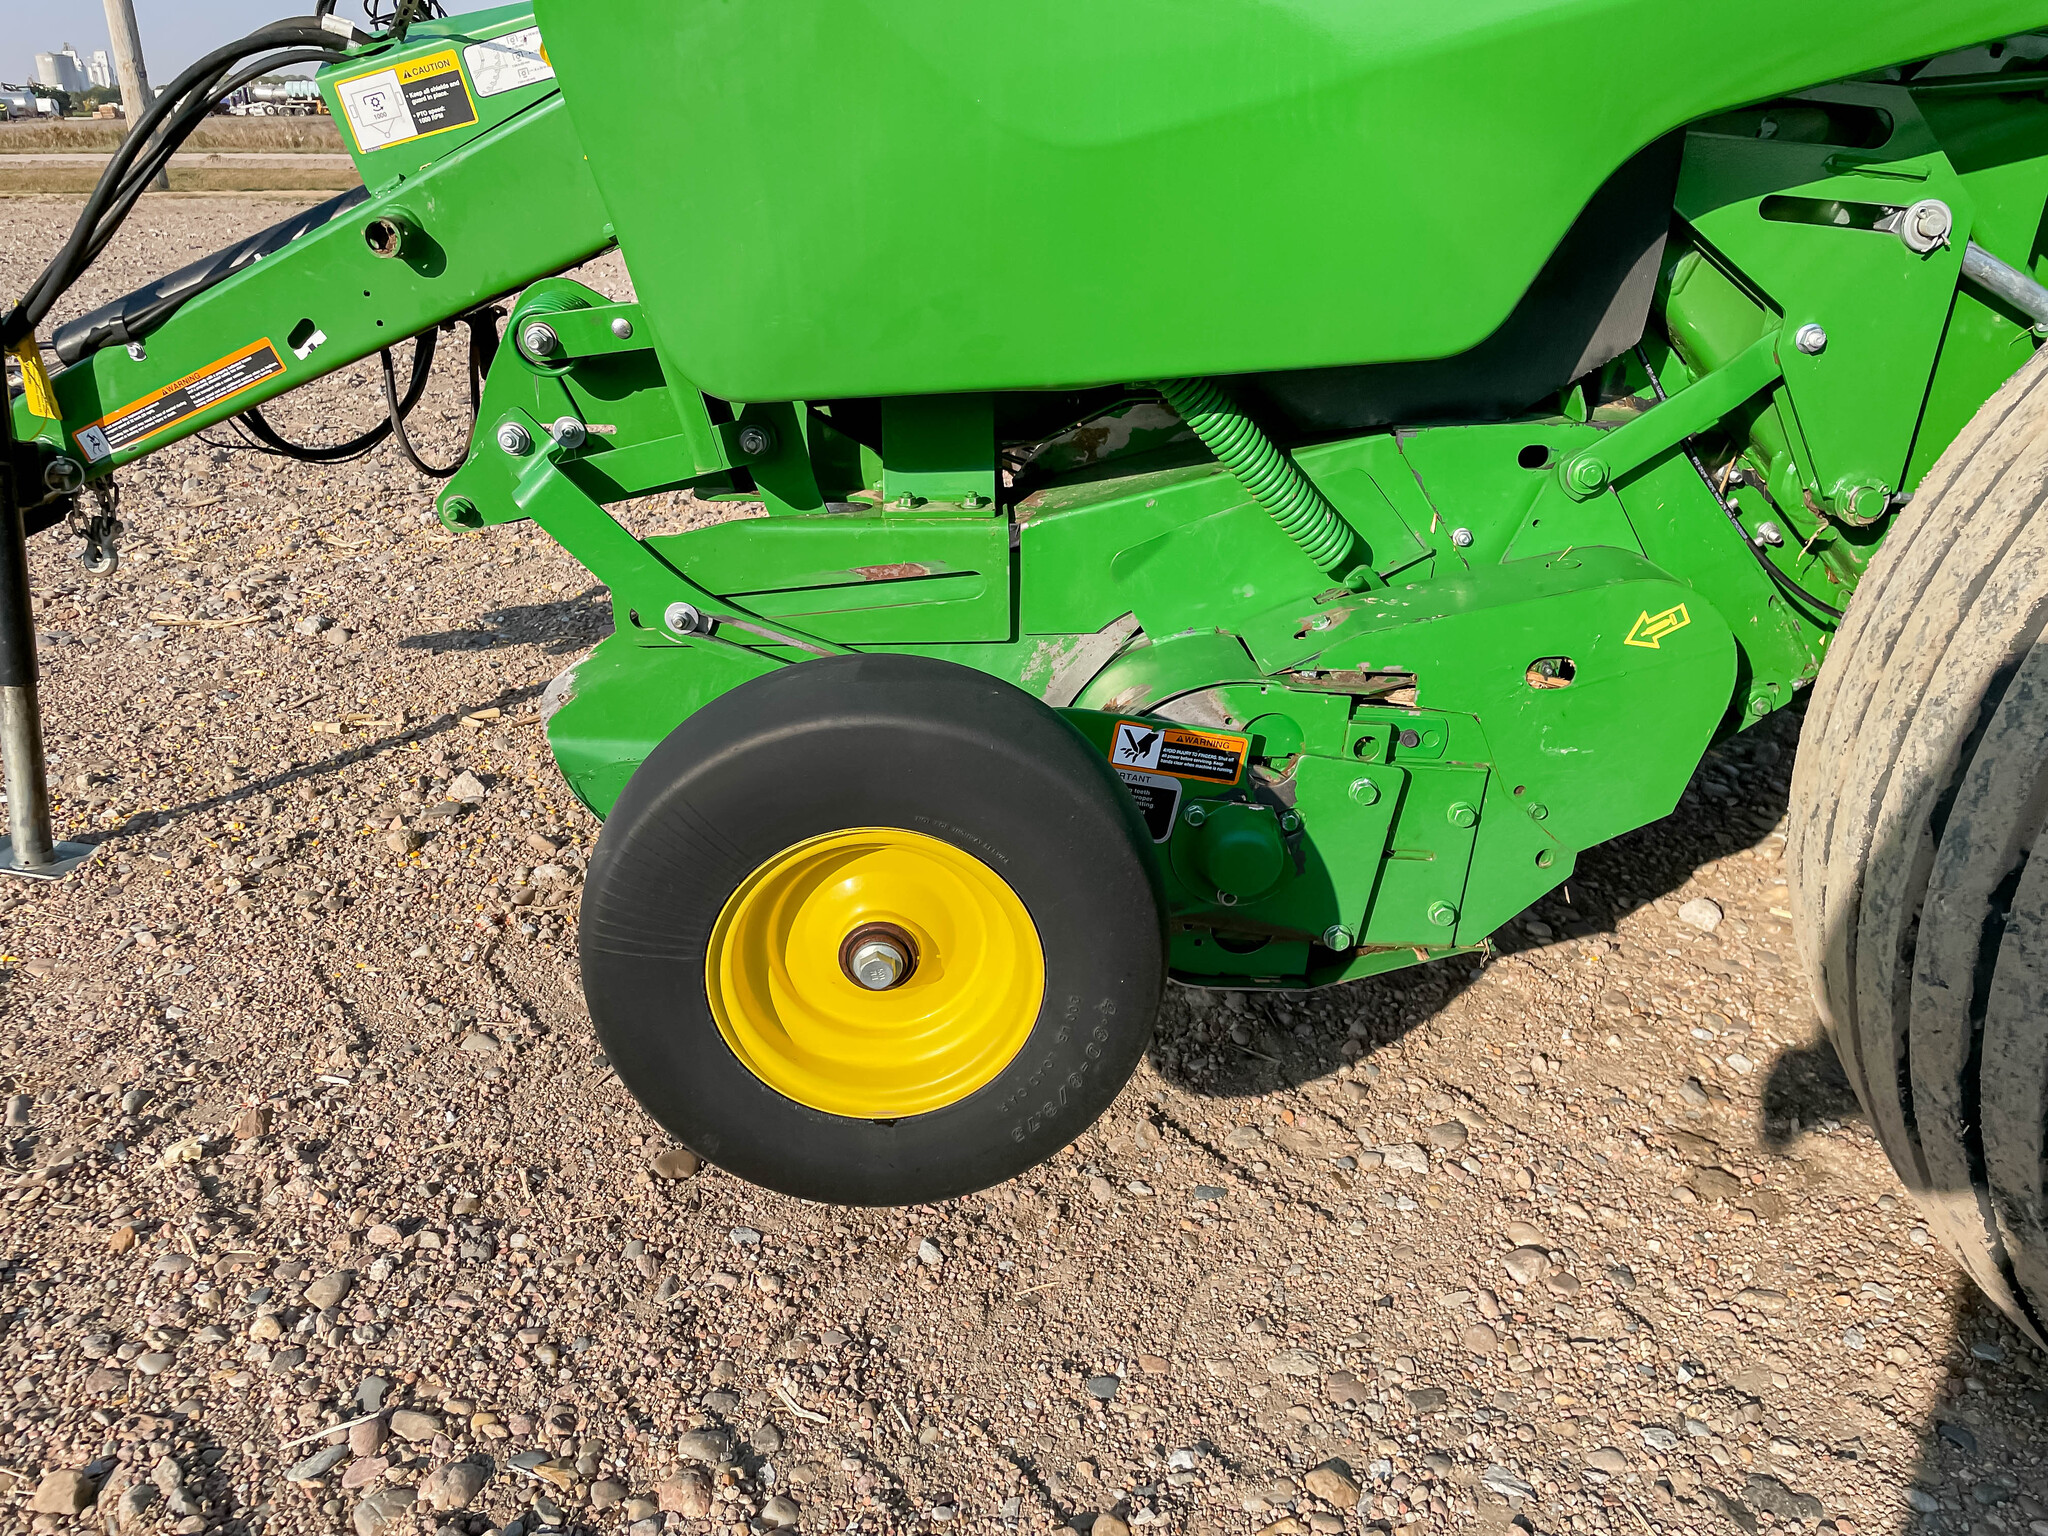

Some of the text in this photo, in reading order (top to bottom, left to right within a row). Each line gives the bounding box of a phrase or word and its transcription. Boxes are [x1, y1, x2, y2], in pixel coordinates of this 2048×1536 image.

[411, 58, 450, 76] CAUTION
[409, 89, 423, 99] Keep
[449, 80, 460, 88] and
[374, 111, 388, 120] 1000
[416, 110, 428, 118] PTO
[431, 112, 444, 121] RPM
[166, 372, 201, 393] WARNING
[1184, 735, 1230, 749] WARNING
